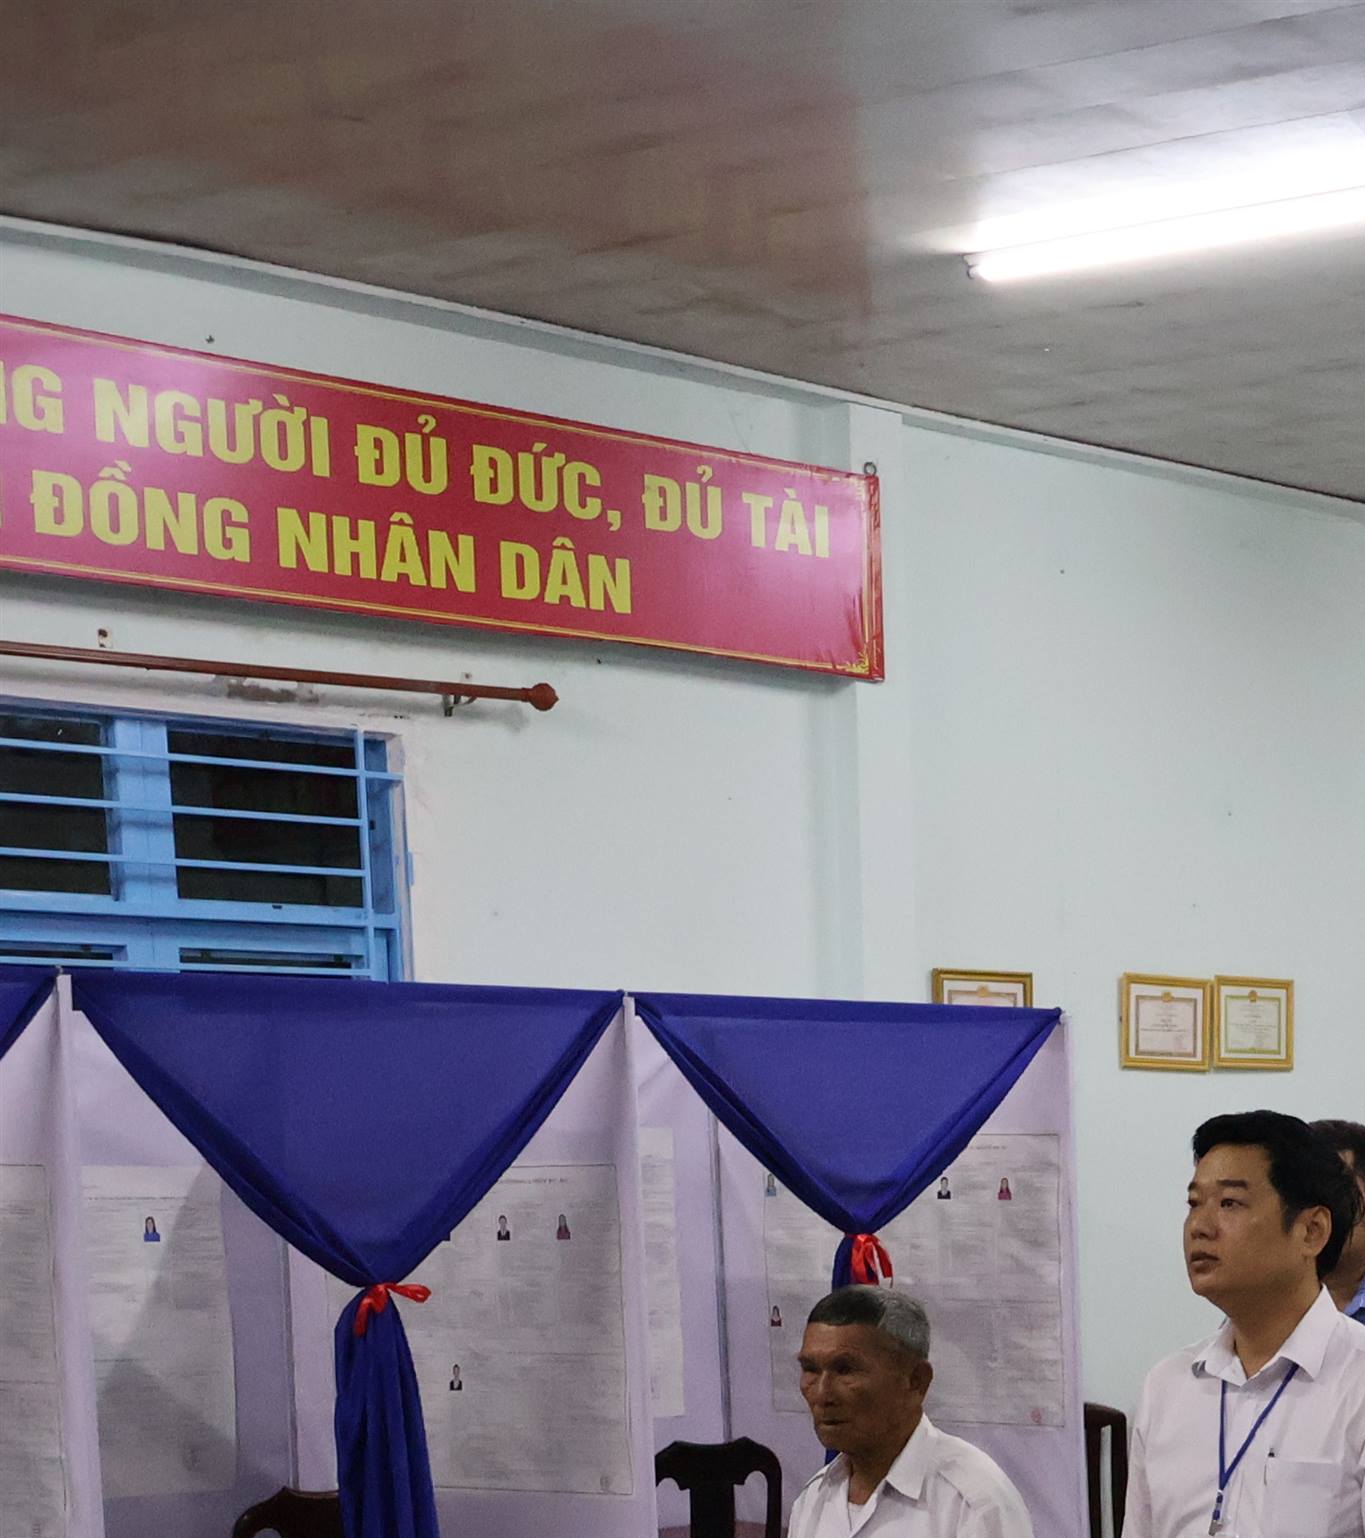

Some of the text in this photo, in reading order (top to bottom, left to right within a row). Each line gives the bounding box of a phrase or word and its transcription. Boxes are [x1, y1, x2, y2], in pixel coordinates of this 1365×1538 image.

[0, 360, 831, 558] G NGƯỜI ĐỦ ĐỨC, ĐỦ TÀI
[30, 459, 632, 615] ĐỒNG NHÂN DÂN
